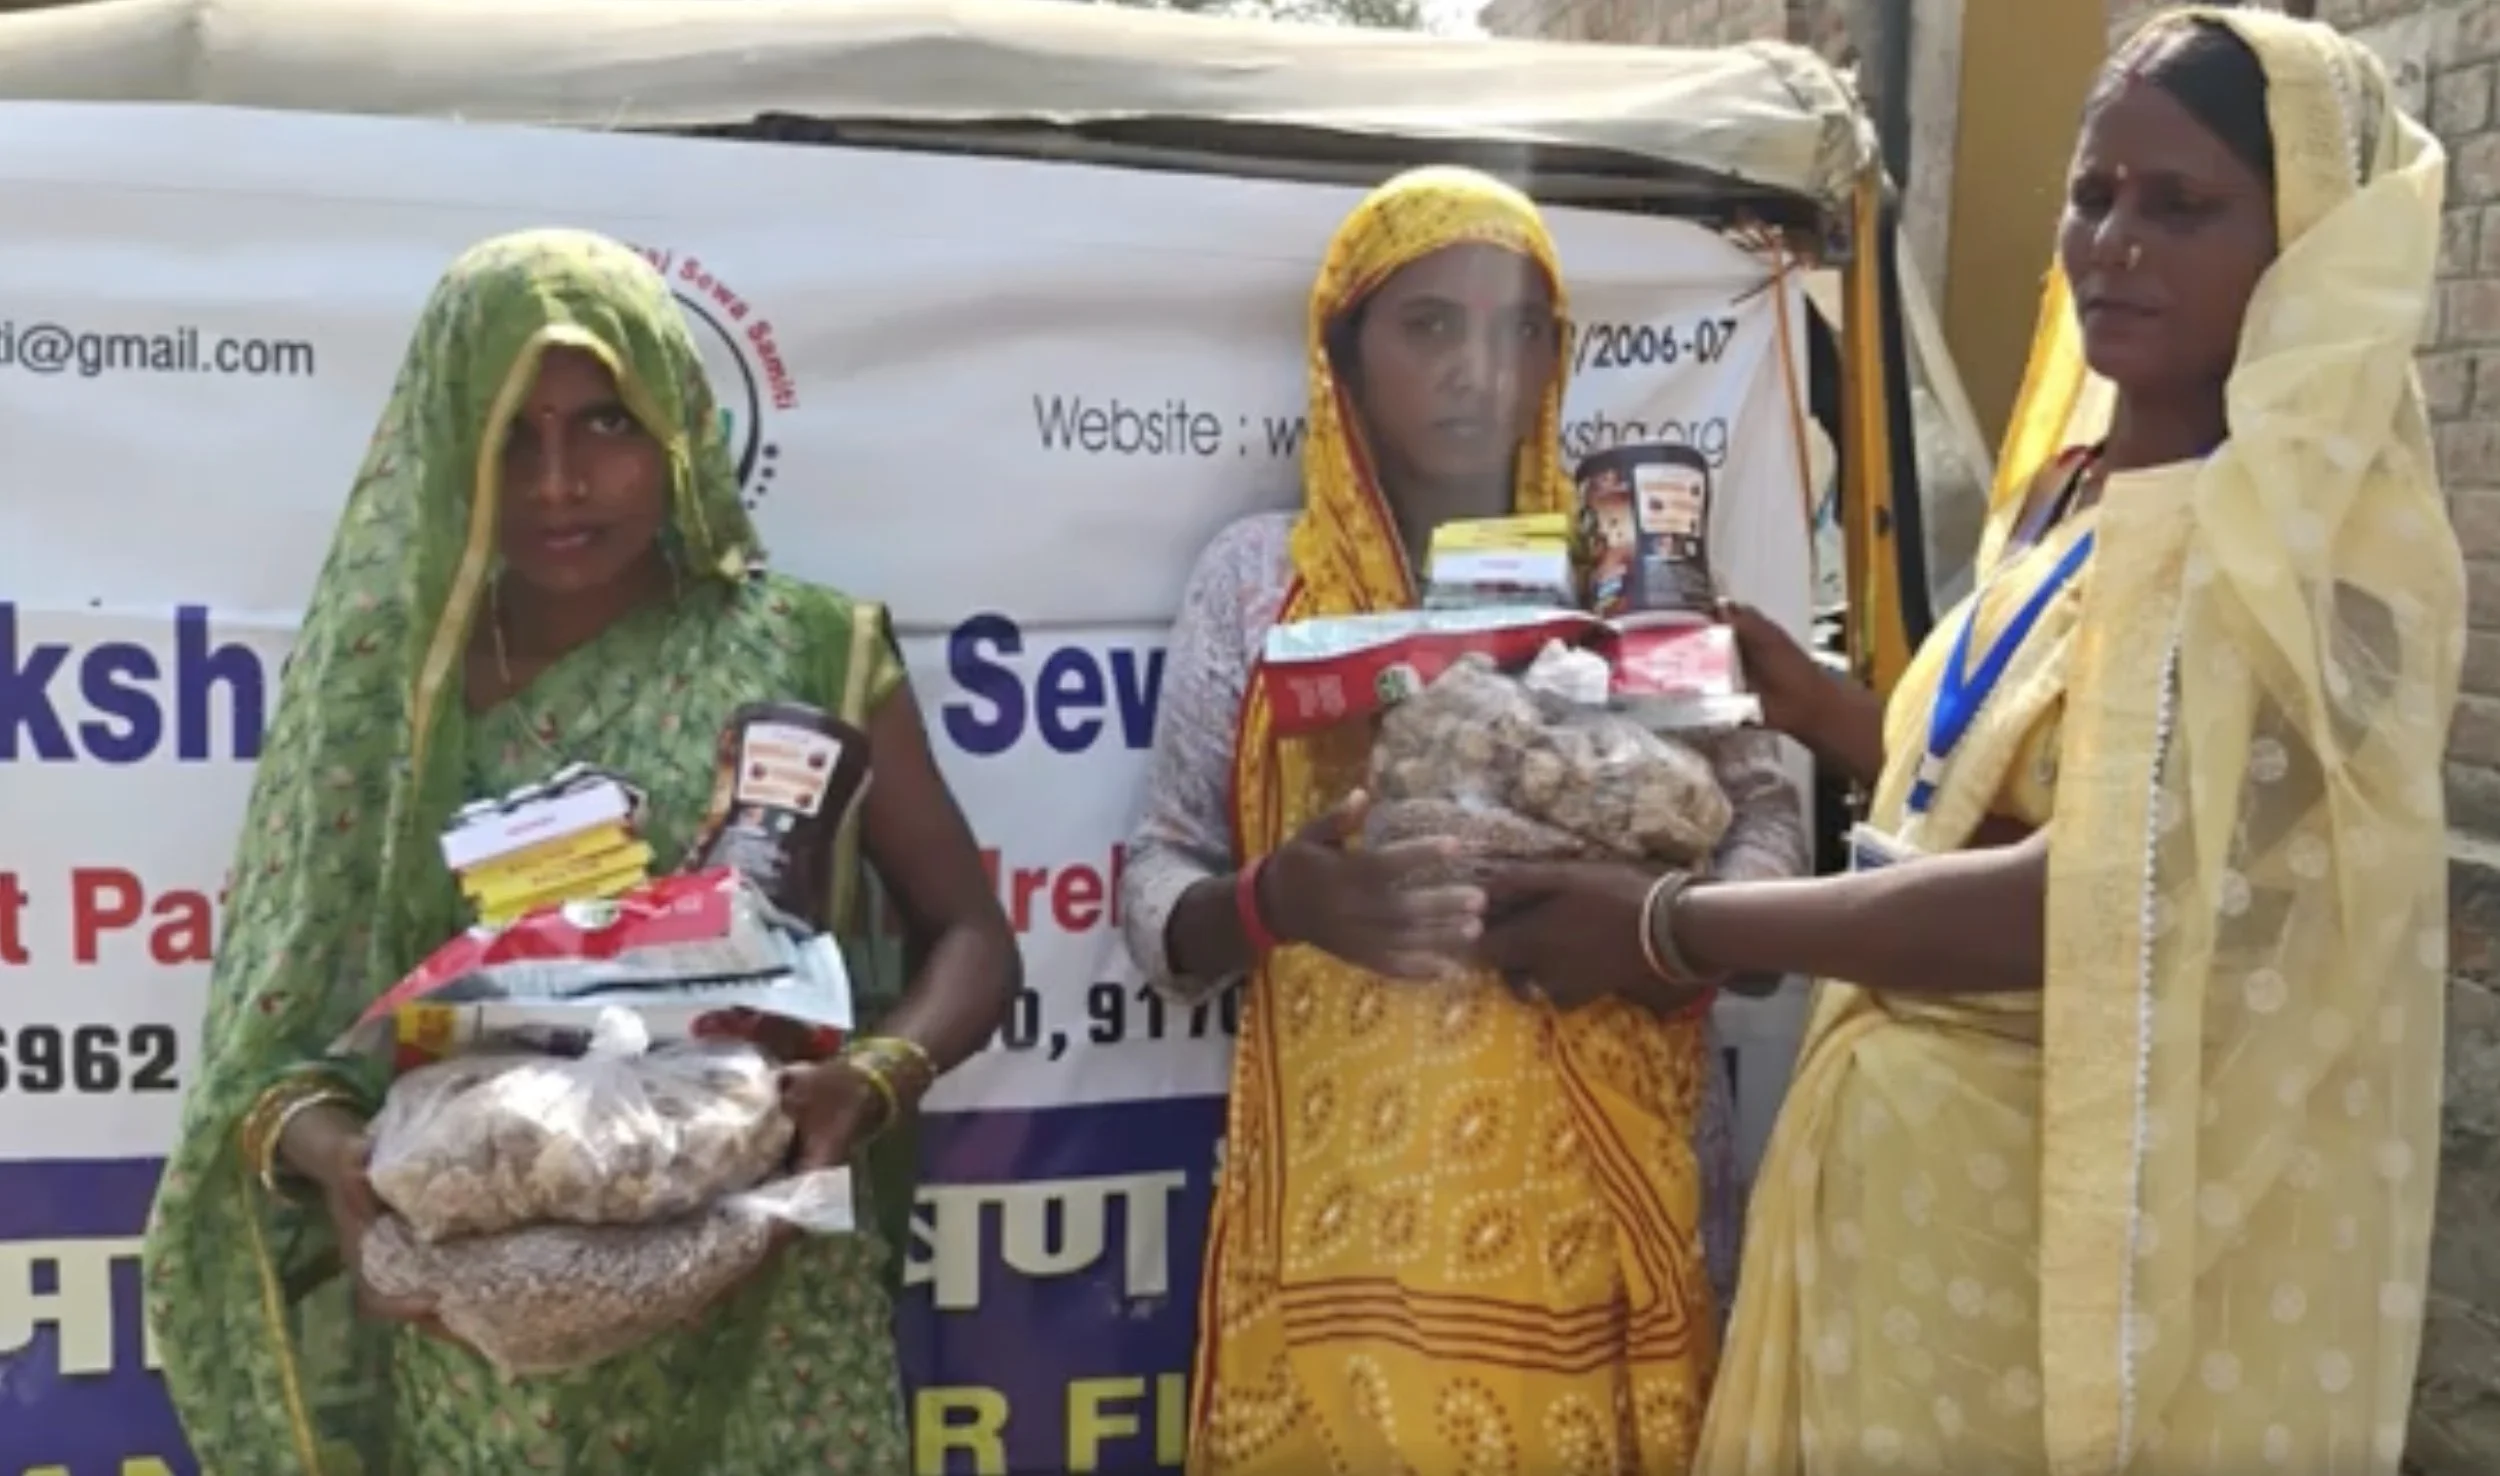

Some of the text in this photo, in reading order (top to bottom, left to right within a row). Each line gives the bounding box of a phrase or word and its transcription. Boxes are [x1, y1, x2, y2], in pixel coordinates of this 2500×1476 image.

[1032, 394, 1222, 456] Website
[71, 867, 228, 966] Pa
[0, 1024, 179, 1093] 962
